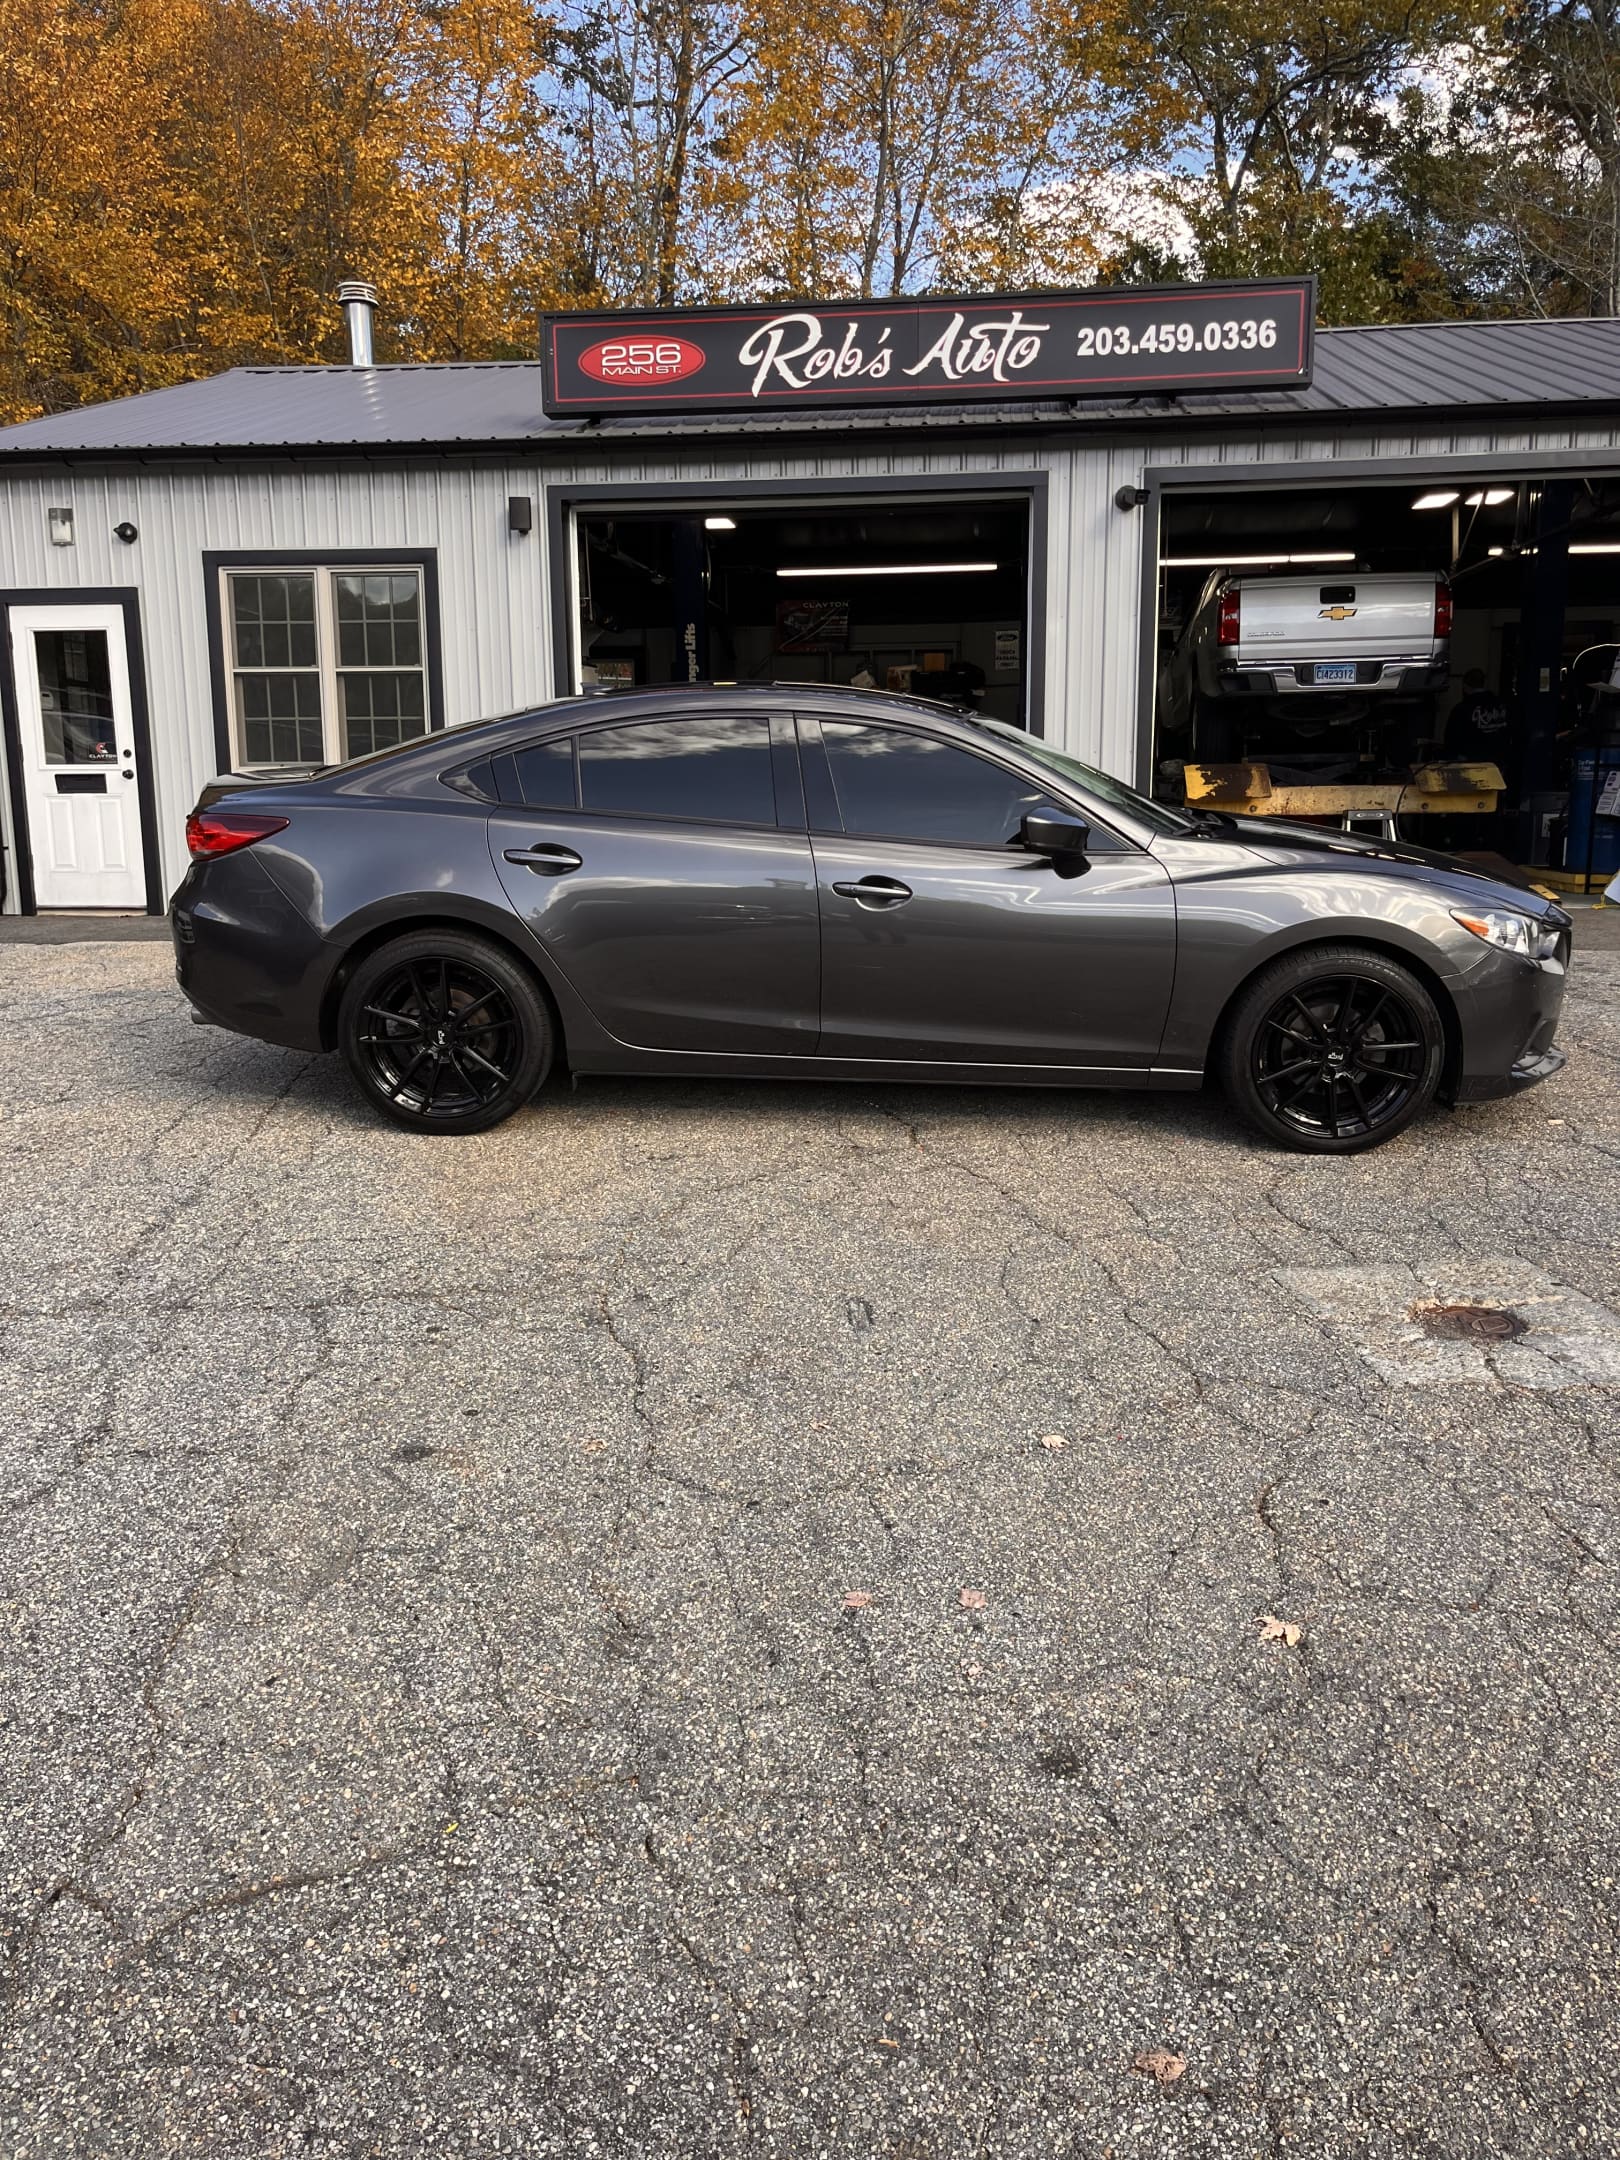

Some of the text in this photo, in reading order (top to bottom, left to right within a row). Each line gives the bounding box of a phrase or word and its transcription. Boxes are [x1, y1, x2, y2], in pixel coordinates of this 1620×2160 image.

[1076, 319, 1278, 357] 203.459.0336
[601, 343, 682, 367] 256
[738, 311, 1051, 398] Rob's Auto
[602, 364, 682, 376] MAIN ST.
[802, 600, 849, 609] CLAYTON
[683, 622, 697, 651] Lifts
